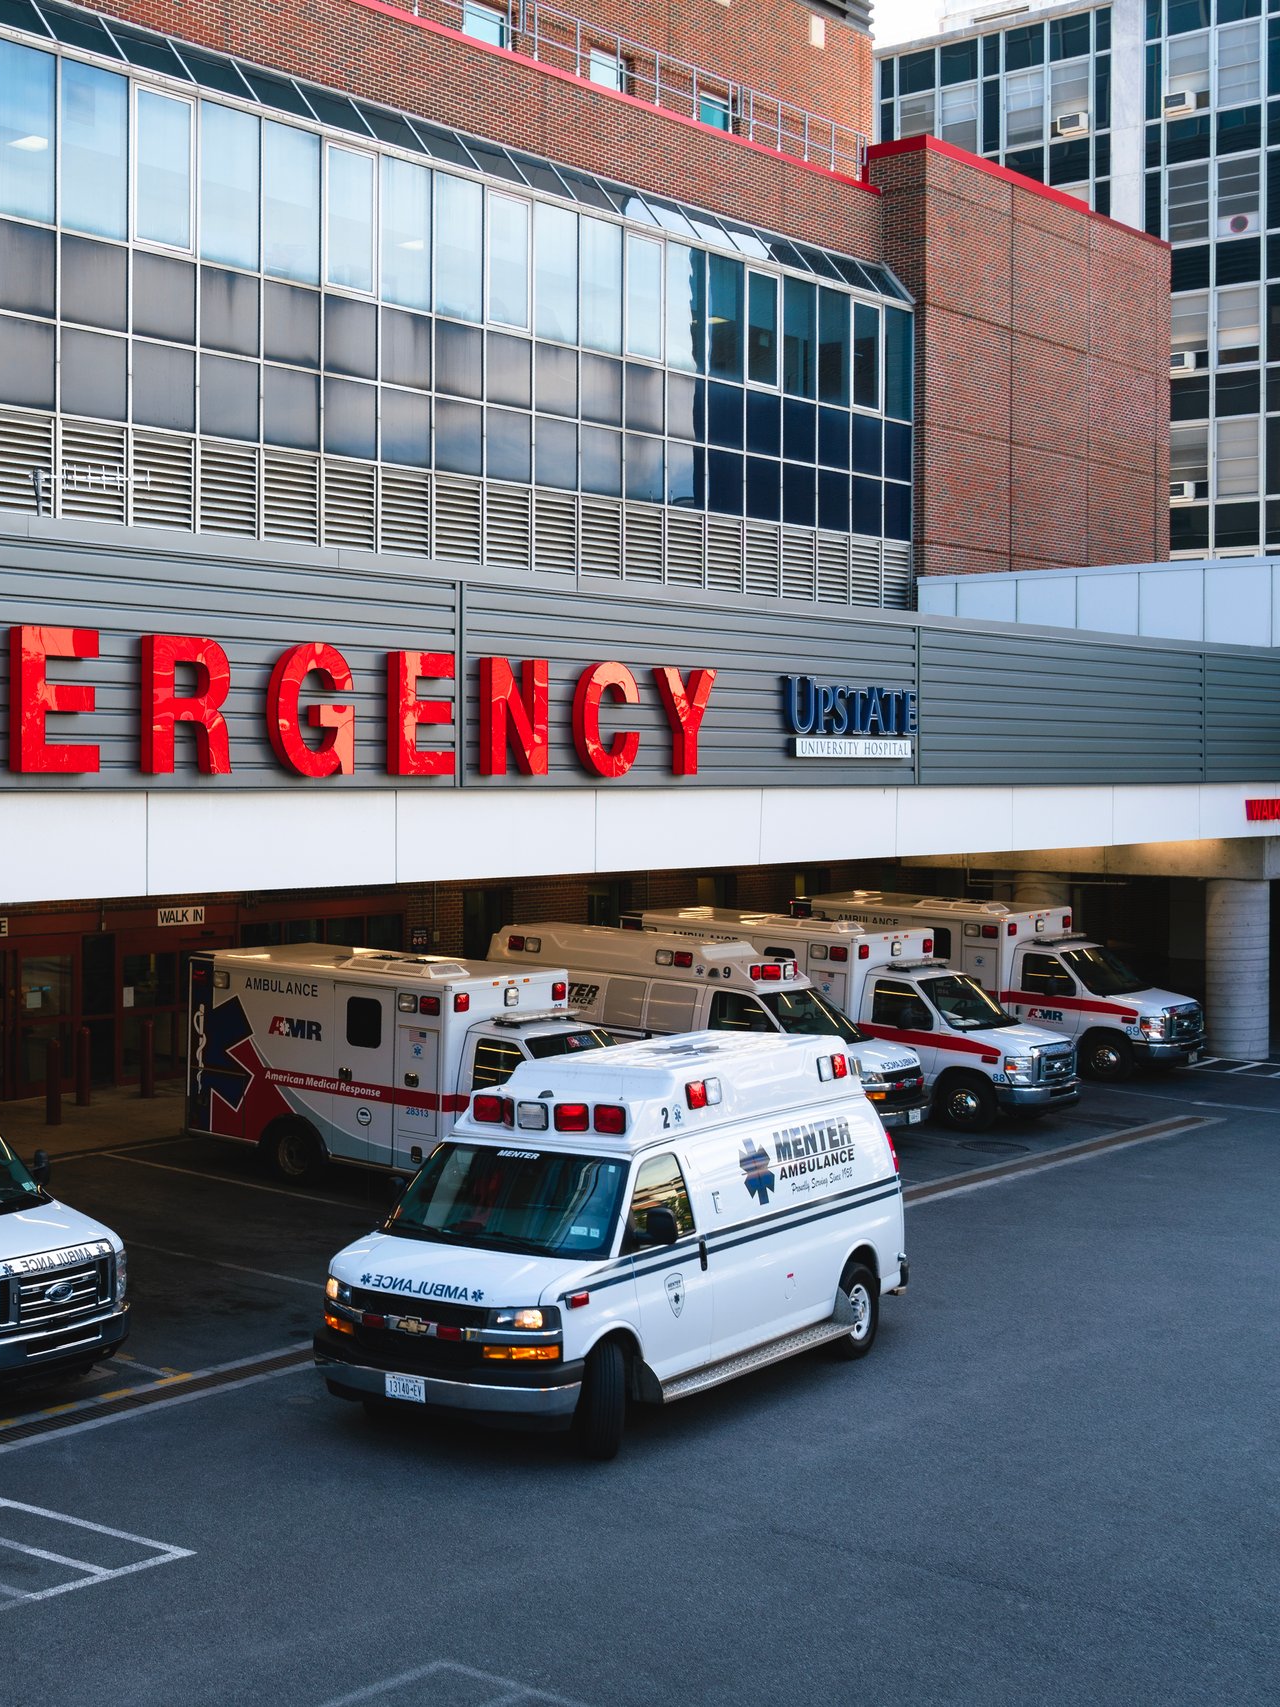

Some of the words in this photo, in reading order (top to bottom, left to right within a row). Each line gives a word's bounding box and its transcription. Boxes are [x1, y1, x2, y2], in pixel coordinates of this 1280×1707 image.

[784, 675, 917, 735] UPSTATE
[800, 741, 860, 755] UNIVERSITY
[864, 742, 909, 755] HOSPITAL
[159, 909, 189, 924] WALK
[192, 908, 203, 922] IN
[722, 966, 731, 978] 9
[245, 976, 318, 997] AMBULANCE
[568, 983, 600, 999] TER
[1028, 1008, 1063, 1021] AMR
[268, 1015, 322, 1042] AMR
[1125, 1025, 1140, 1036] 89
[265, 1070, 304, 1085] American
[305, 1077, 339, 1091] Medical
[340, 1082, 381, 1097] Response
[992, 1073, 1005, 1083] 88
[405, 1106, 429, 1118] 28313
[661, 1106, 670, 1129] 2
[772, 1116, 852, 1163] MENTER
[496, 1149, 540, 1160] MENTER
[780, 1148, 855, 1180] AMBULANCE
